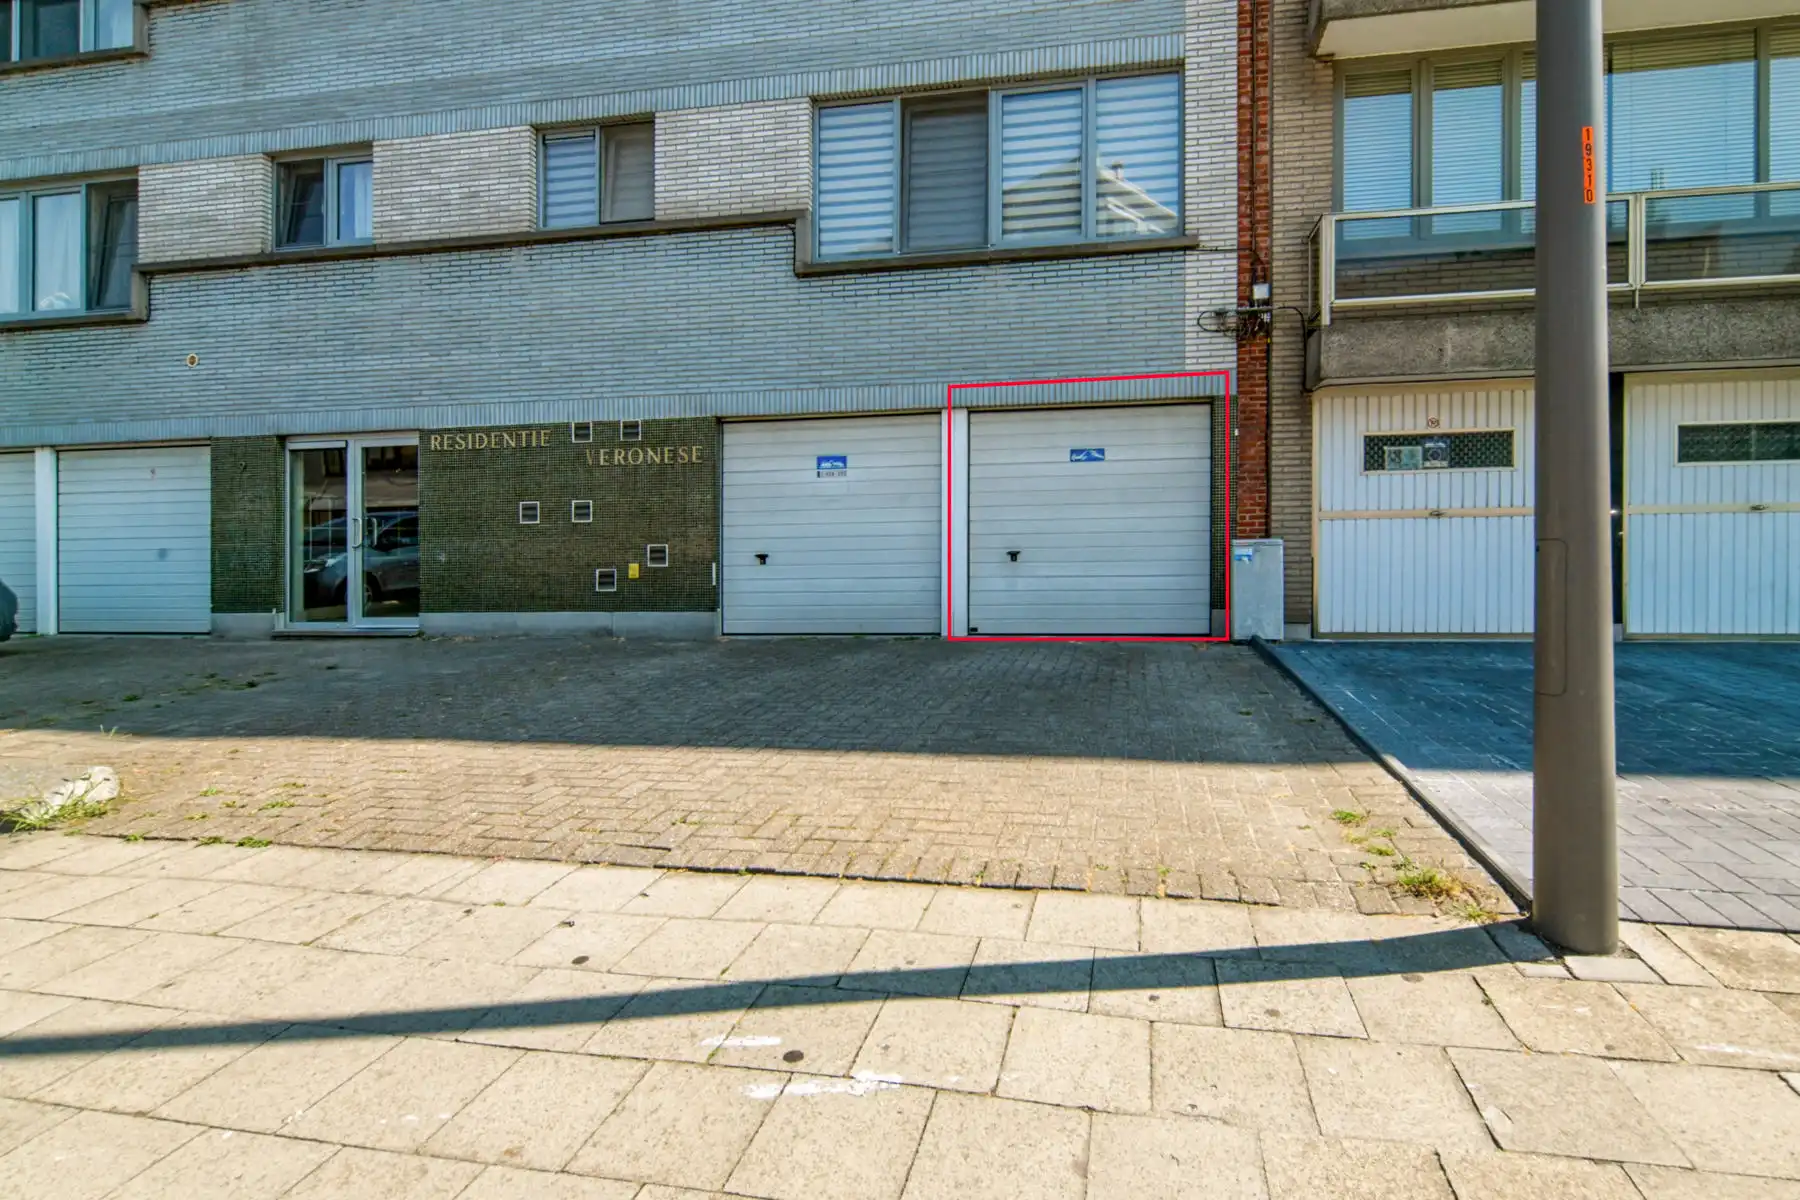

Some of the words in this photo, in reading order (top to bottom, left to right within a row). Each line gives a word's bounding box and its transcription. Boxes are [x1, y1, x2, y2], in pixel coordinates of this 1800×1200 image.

[1585, 127, 1593, 202] 19310
[430, 429, 552, 451] RESIDENTIE
[586, 445, 703, 466] VERONESE
